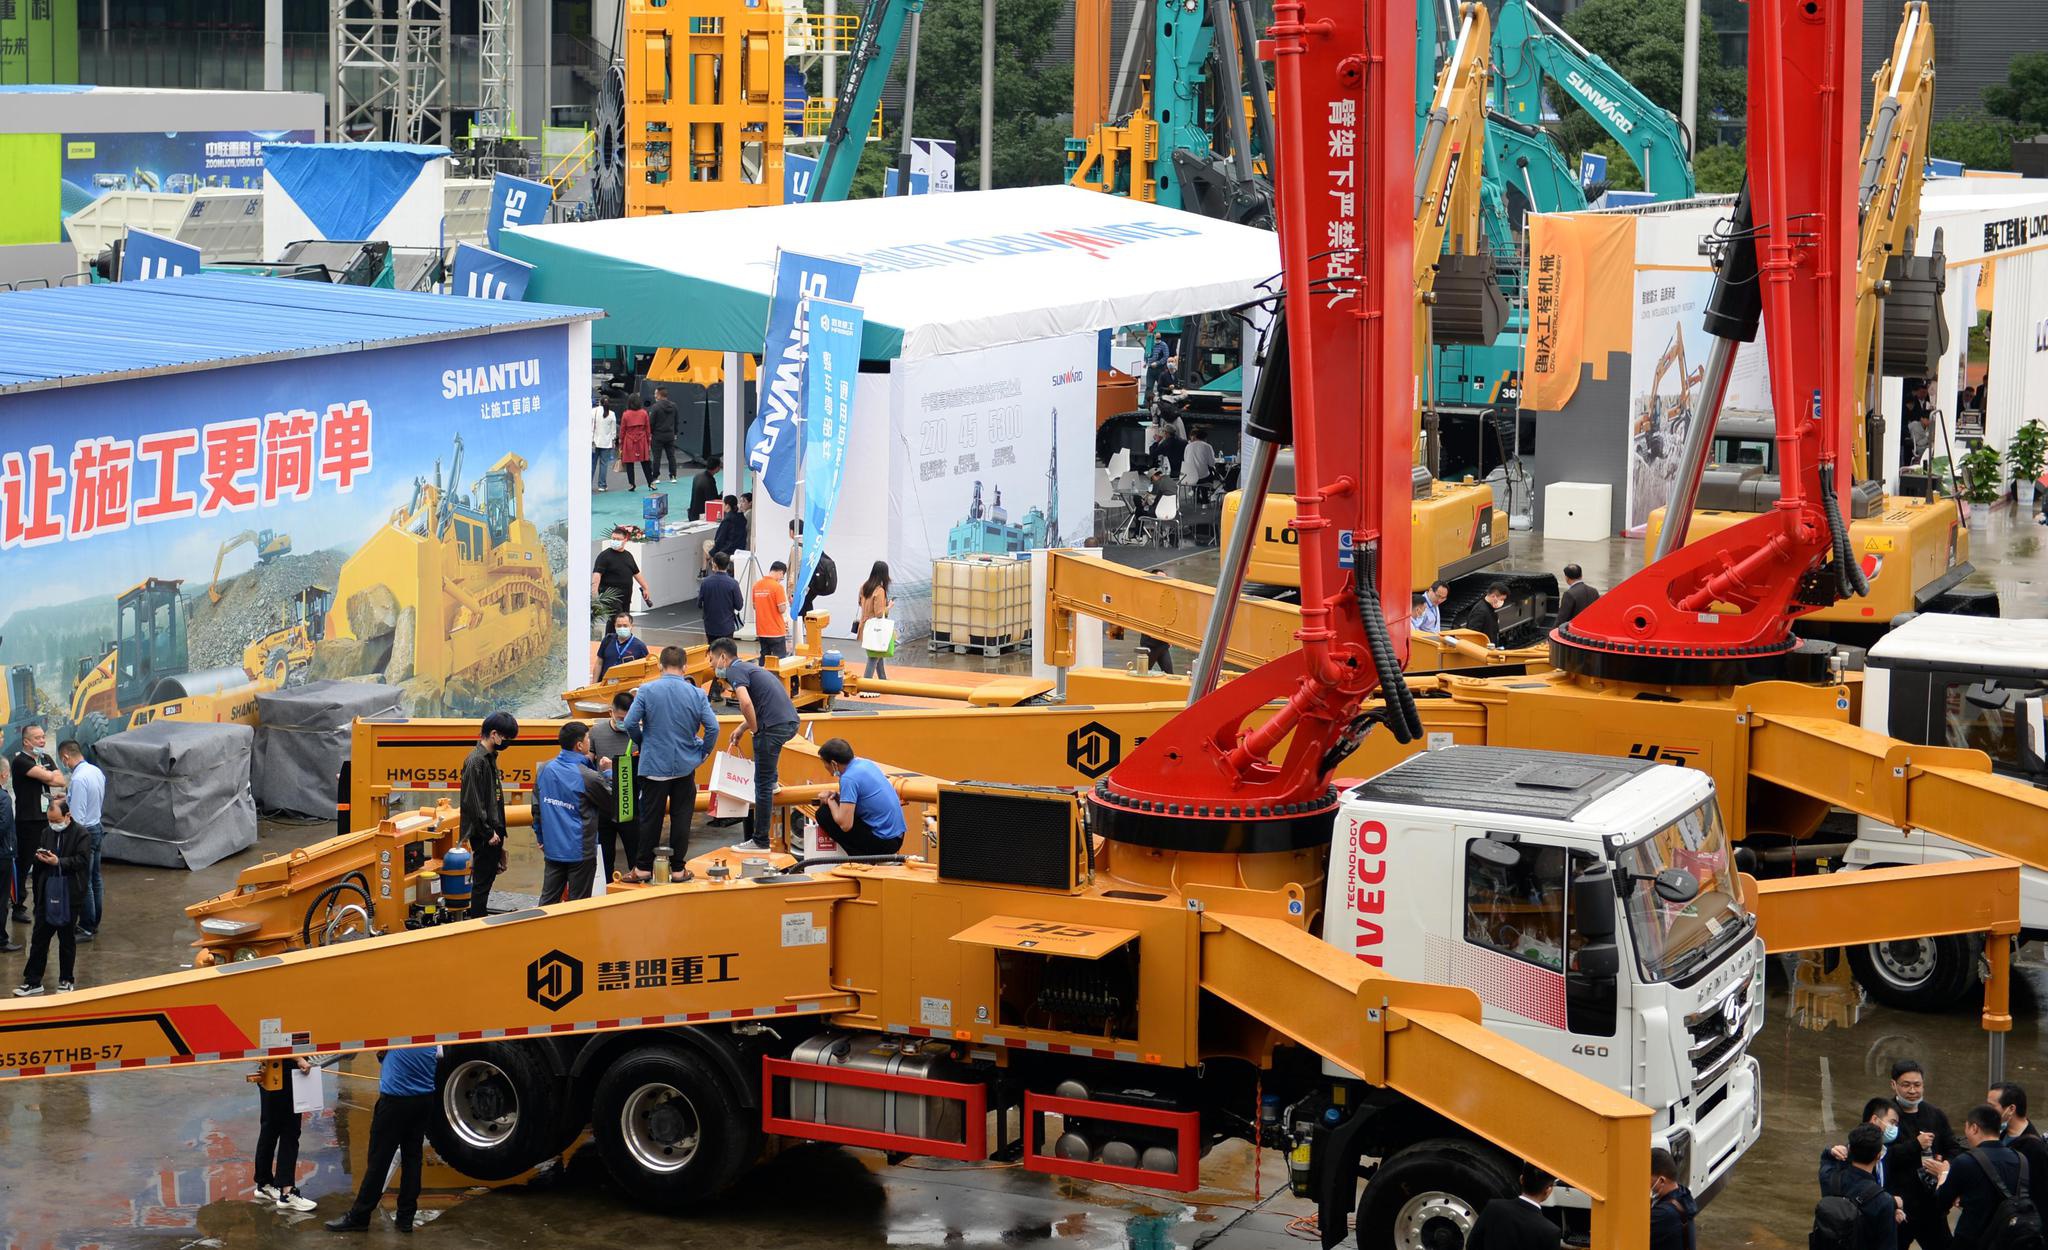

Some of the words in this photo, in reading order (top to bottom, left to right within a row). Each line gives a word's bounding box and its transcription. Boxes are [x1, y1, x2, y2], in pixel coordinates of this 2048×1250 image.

[1566, 71, 1633, 134] SUNWARD
[1327, 98, 1356, 309] 臂架下严禁站人
[1438, 160, 1458, 225] LOVOL
[945, 221, 1202, 260] SUNWARD
[1984, 216, 2027, 253] 雷沃工程机械
[1535, 254, 1555, 373] 雷沃工程机械
[442, 359, 540, 399] SHANTUI
[1052, 366, 1083, 387] SUNWARD
[481, 395, 541, 419] 让施工更简单
[1, 400, 373, 548] 让施工更简单
[726, 772, 749, 785] SANY
[1347, 818, 1358, 910] TECHNOLOGY
[597, 953, 740, 992] 慧盟重工
[1571, 1043, 1609, 1058] 460
